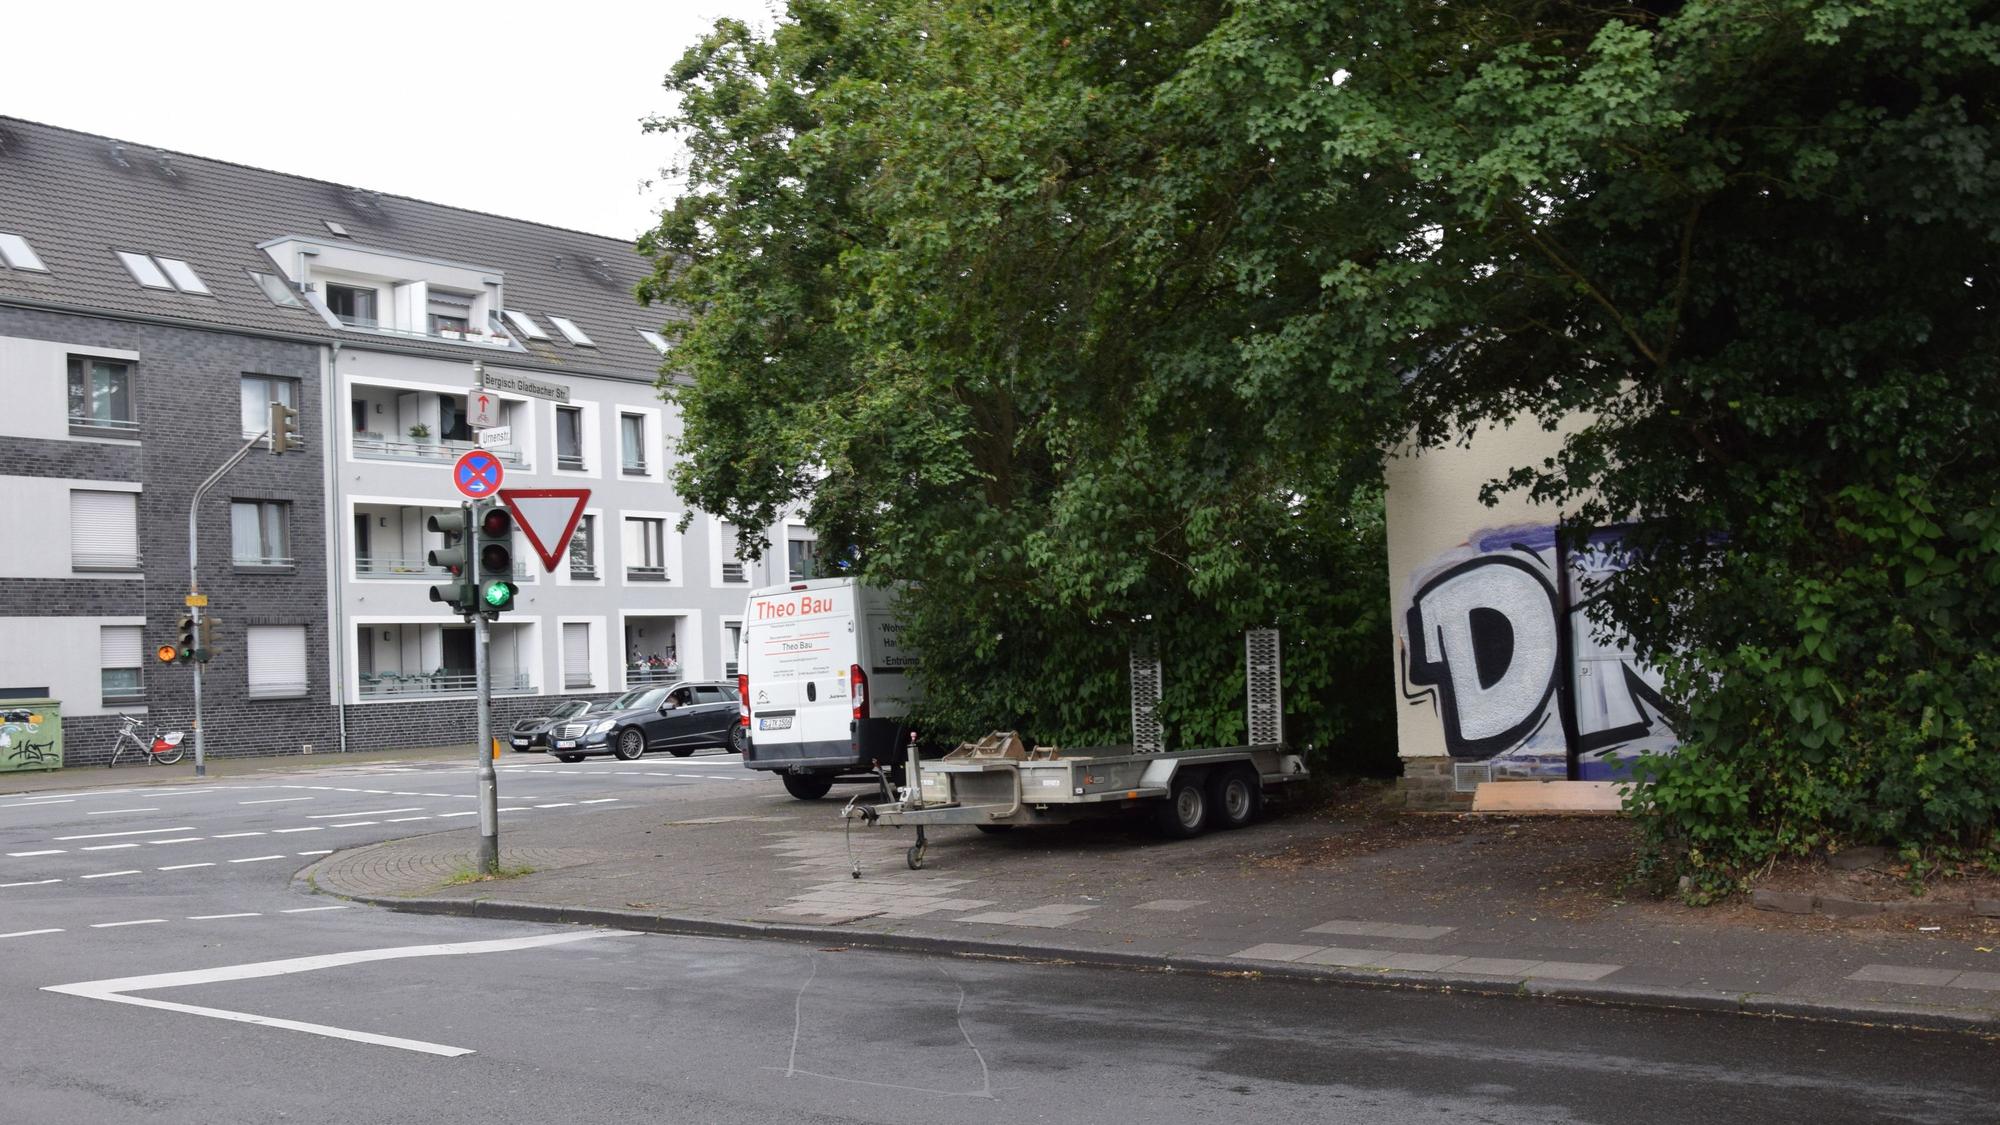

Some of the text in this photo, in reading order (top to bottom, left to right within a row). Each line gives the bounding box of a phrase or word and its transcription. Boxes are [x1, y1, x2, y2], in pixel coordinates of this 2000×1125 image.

[485, 374, 567, 399] Bergisch Gladbacher Str.
[482, 431, 510, 444] Urnenstr.
[756, 596, 833, 620] Theo Bau
[782, 641, 813, 651] Theo Bau
